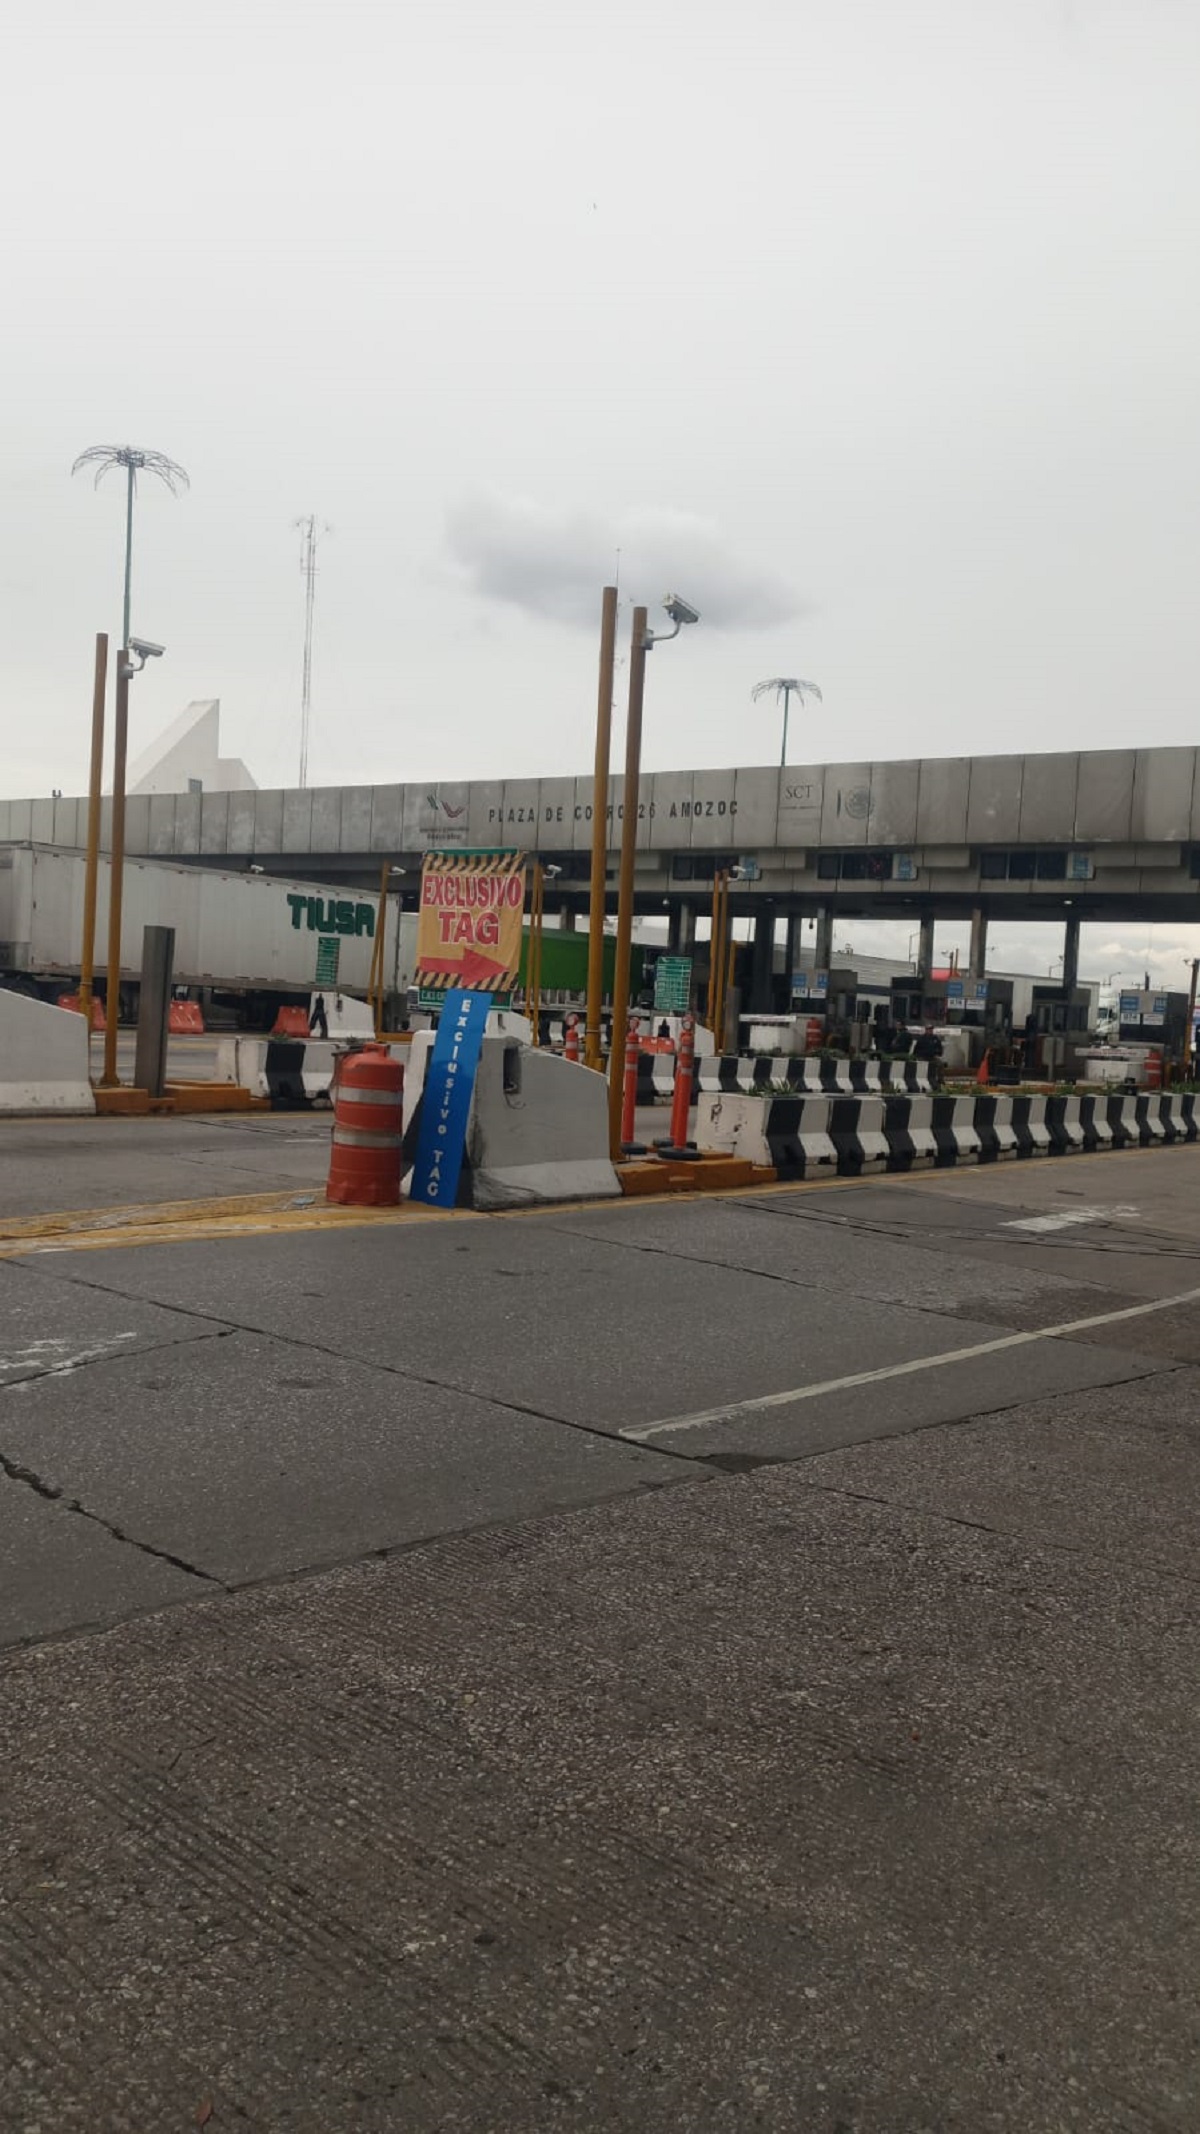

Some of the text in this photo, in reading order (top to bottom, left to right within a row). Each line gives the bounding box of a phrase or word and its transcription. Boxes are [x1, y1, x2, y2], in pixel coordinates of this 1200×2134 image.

[784, 784, 813, 800] SCT
[488, 808, 535, 823] PLAZA
[545, 806, 563, 822] DE
[574, 804, 624, 820] CORO
[669, 801, 738, 819] AMOZOC
[422, 873, 523, 908] EXCLUSIVO
[286, 893, 376, 938] TIUSA
[438, 910, 500, 946] TAG
[426, 1150, 444, 1197] TAG
